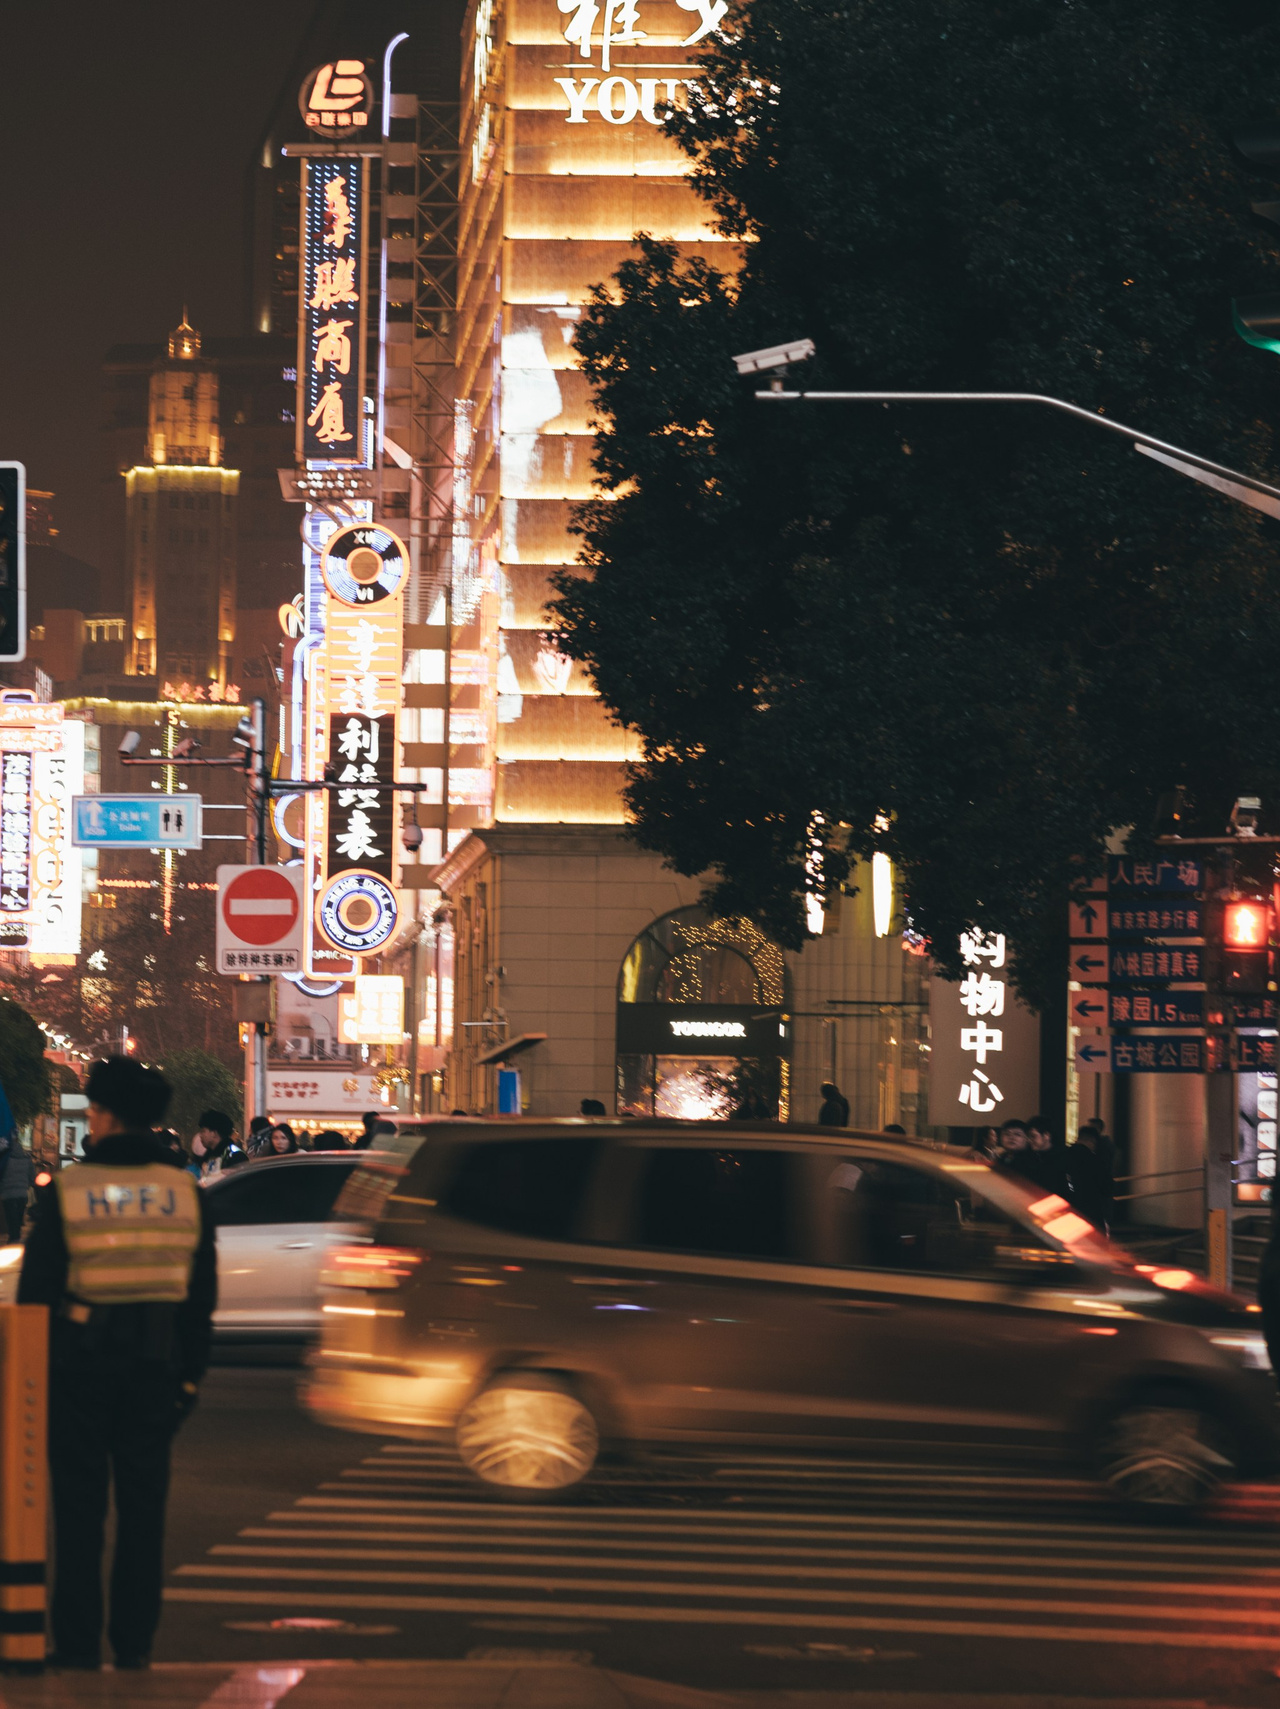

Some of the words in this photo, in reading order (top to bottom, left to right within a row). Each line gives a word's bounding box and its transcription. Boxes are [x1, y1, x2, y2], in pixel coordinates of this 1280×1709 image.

[1111, 860, 1200, 887] 人民广场
[1112, 951, 1200, 977] 小桃园清真寺
[958, 926, 1006, 1112] 购物中心
[1111, 996, 1152, 1022] 豫园
[1113, 1042, 1200, 1068] 古城公园
